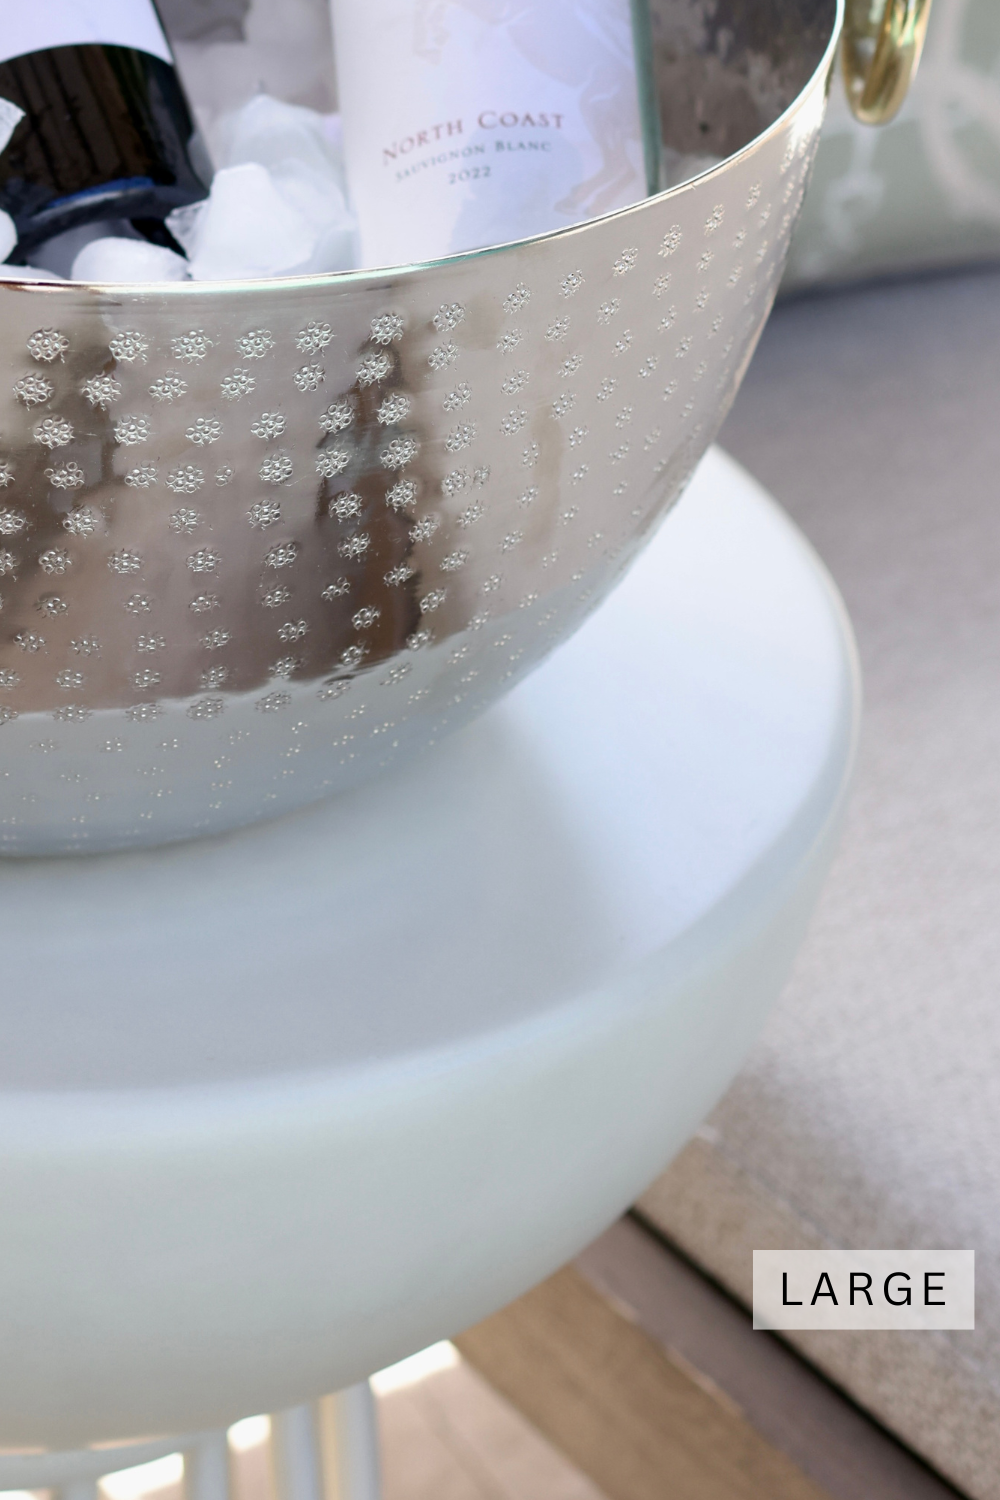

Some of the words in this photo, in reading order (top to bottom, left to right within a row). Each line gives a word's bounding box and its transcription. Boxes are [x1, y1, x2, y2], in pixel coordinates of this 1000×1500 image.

[383, 118, 463, 166] NORTH
[477, 110, 564, 130] COAST
[396, 142, 486, 184] SAUVIGNON
[494, 140, 552, 153] BLANC
[447, 166, 492, 186] 2022
